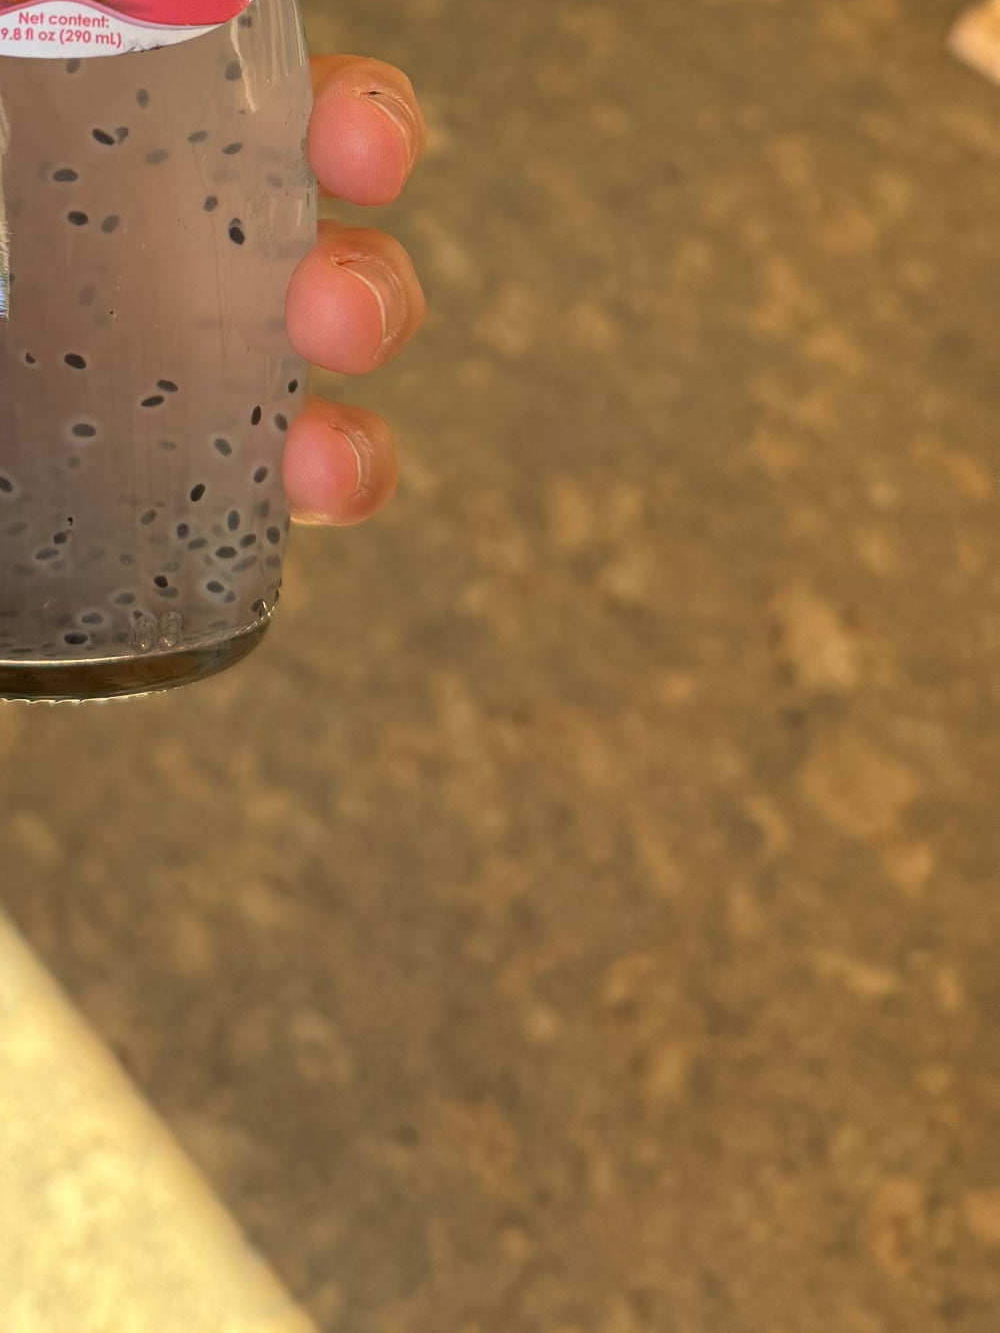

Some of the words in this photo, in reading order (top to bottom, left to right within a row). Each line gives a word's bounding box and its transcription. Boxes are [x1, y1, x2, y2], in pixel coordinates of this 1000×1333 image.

[18, 11, 45, 25] Net
[48, 13, 110, 29] content:
[0, 27, 22, 41] 9.8
[25, 27, 34, 41] fl
[38, 30, 56, 42] oz
[59, 28, 91, 45] (290
[95, 32, 122, 49] mL)
